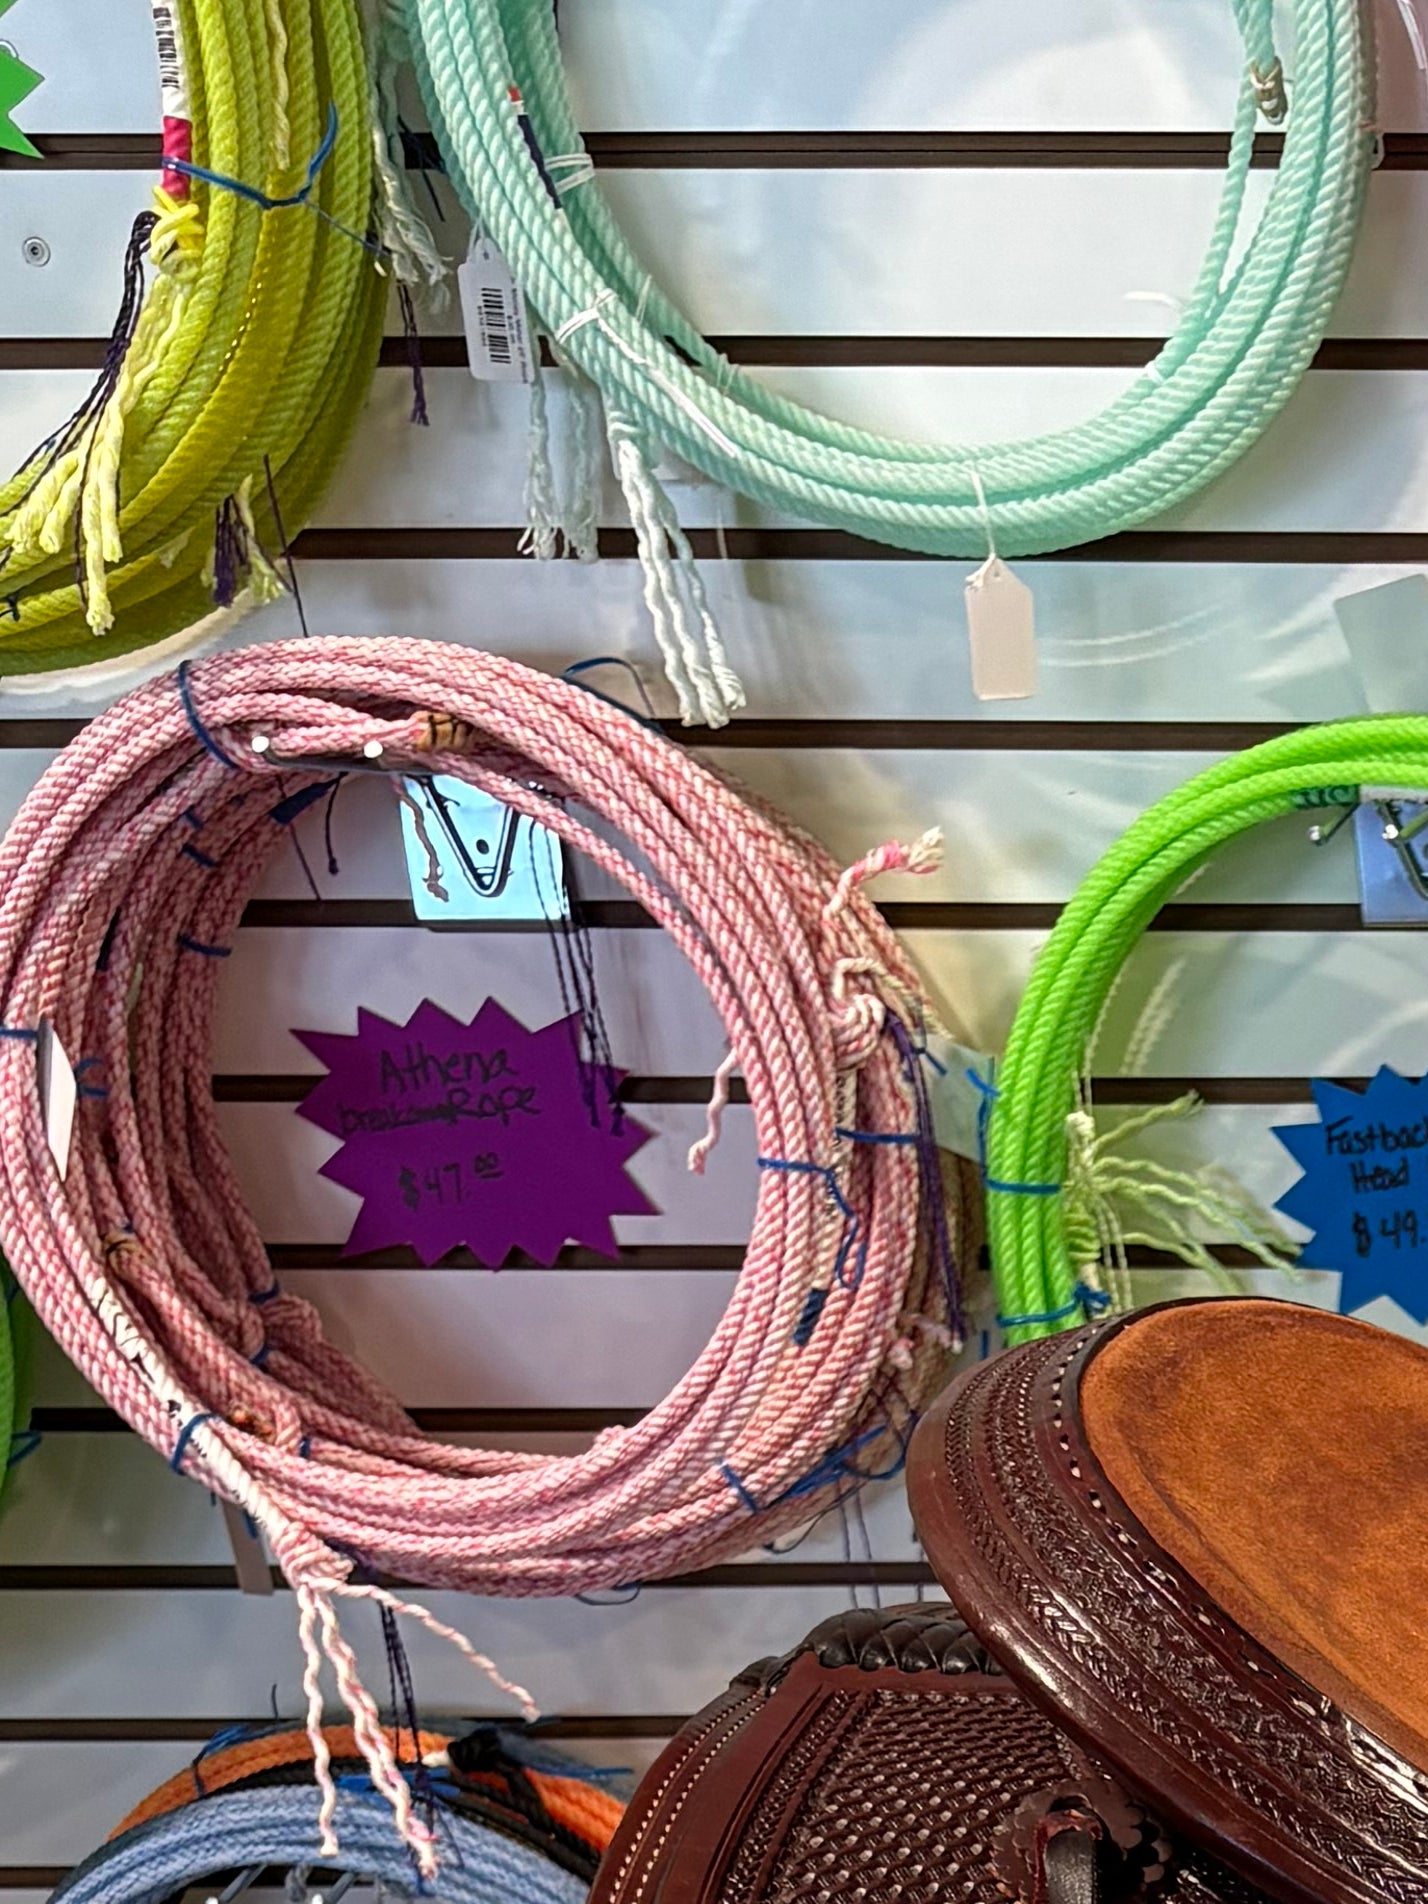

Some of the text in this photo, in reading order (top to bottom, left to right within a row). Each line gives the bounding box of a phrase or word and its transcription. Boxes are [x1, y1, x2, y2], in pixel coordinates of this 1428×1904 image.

[380, 1042, 520, 1093] Athena
[447, 1086, 541, 1126] Rope
[1351, 1157, 1410, 1194] Head
